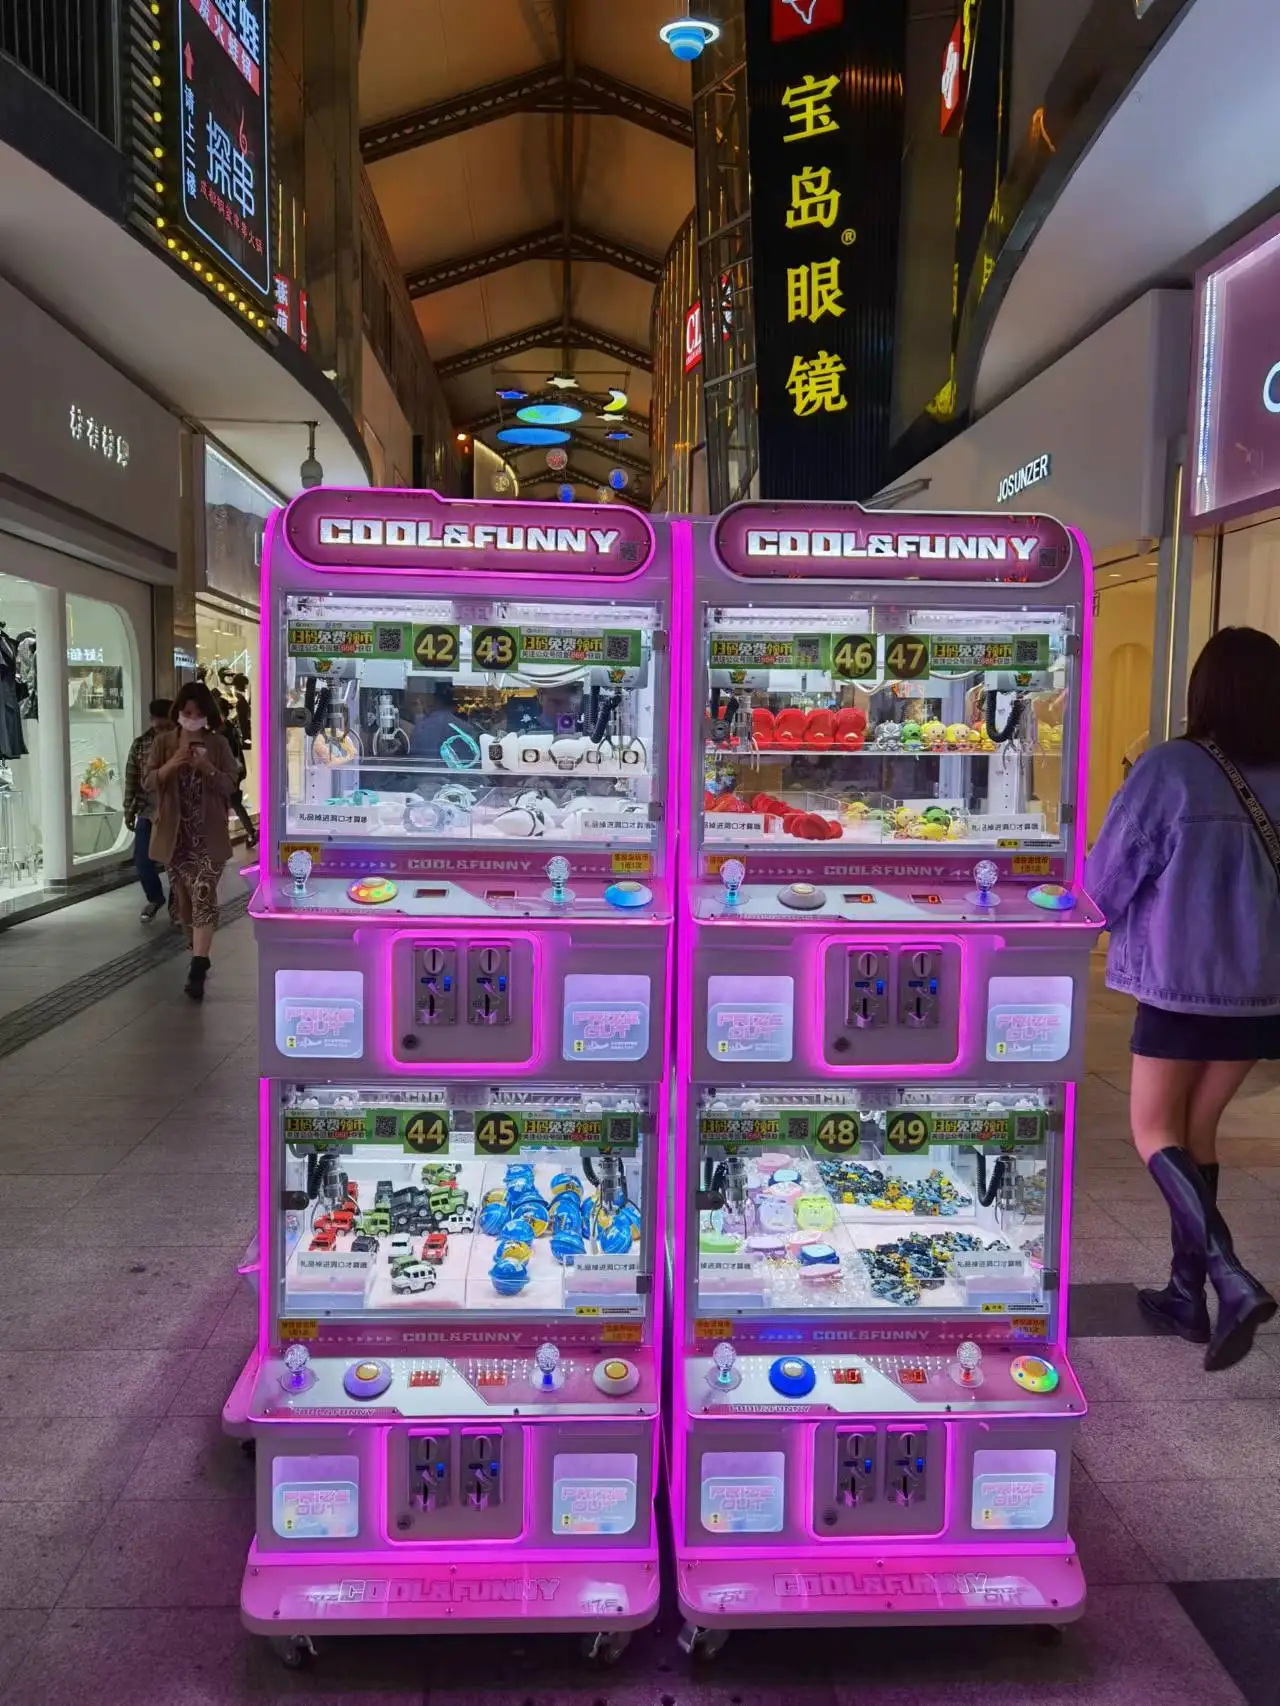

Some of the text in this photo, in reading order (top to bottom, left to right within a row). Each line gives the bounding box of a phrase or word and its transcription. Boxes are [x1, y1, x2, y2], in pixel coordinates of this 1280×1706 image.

[997, 453, 1048, 503] JOSUNZER
[319, 517, 619, 554] COOL&FUNNY
[747, 530, 1039, 561] COOL&FUNNY
[417, 634, 453, 661] 42
[475, 635, 513, 662] 43
[835, 643, 873, 669] 46
[888, 643, 924, 670] 47
[407, 858, 532, 872] COOL&FUNNY
[823, 865, 945, 876] COOL&FUNNY
[408, 1119, 445, 1145] 44
[478, 1120, 515, 1146] 45
[818, 1119, 855, 1146] 48
[888, 1119, 925, 1146] 49
[402, 1332, 523, 1343] COOL&FUNNY
[813, 1330, 930, 1341] COOL&FUNNY
